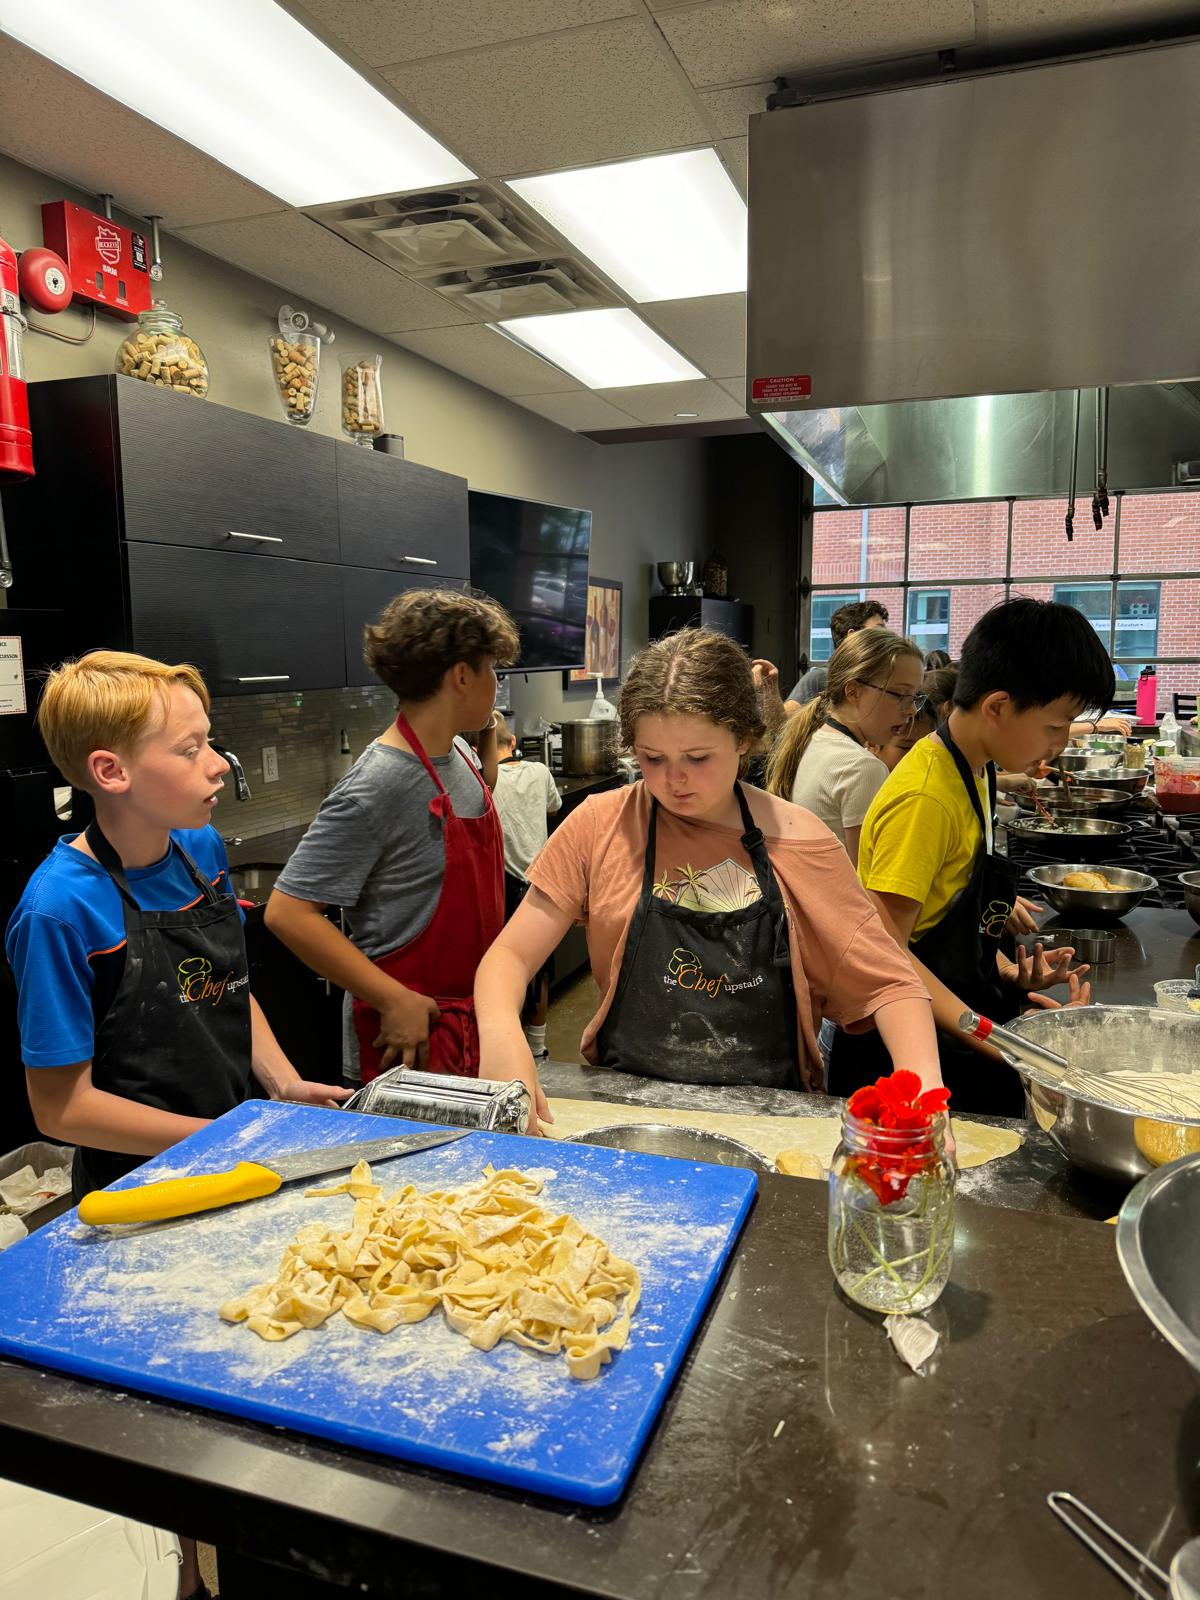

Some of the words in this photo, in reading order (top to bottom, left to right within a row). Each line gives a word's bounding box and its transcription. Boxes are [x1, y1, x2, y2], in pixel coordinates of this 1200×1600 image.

[102, 264, 118, 277] SRM
[186, 971, 235, 1006] Chef
[663, 975, 678, 986] the
[677, 969, 729, 998] Chef
[723, 975, 764, 994] upstairs
